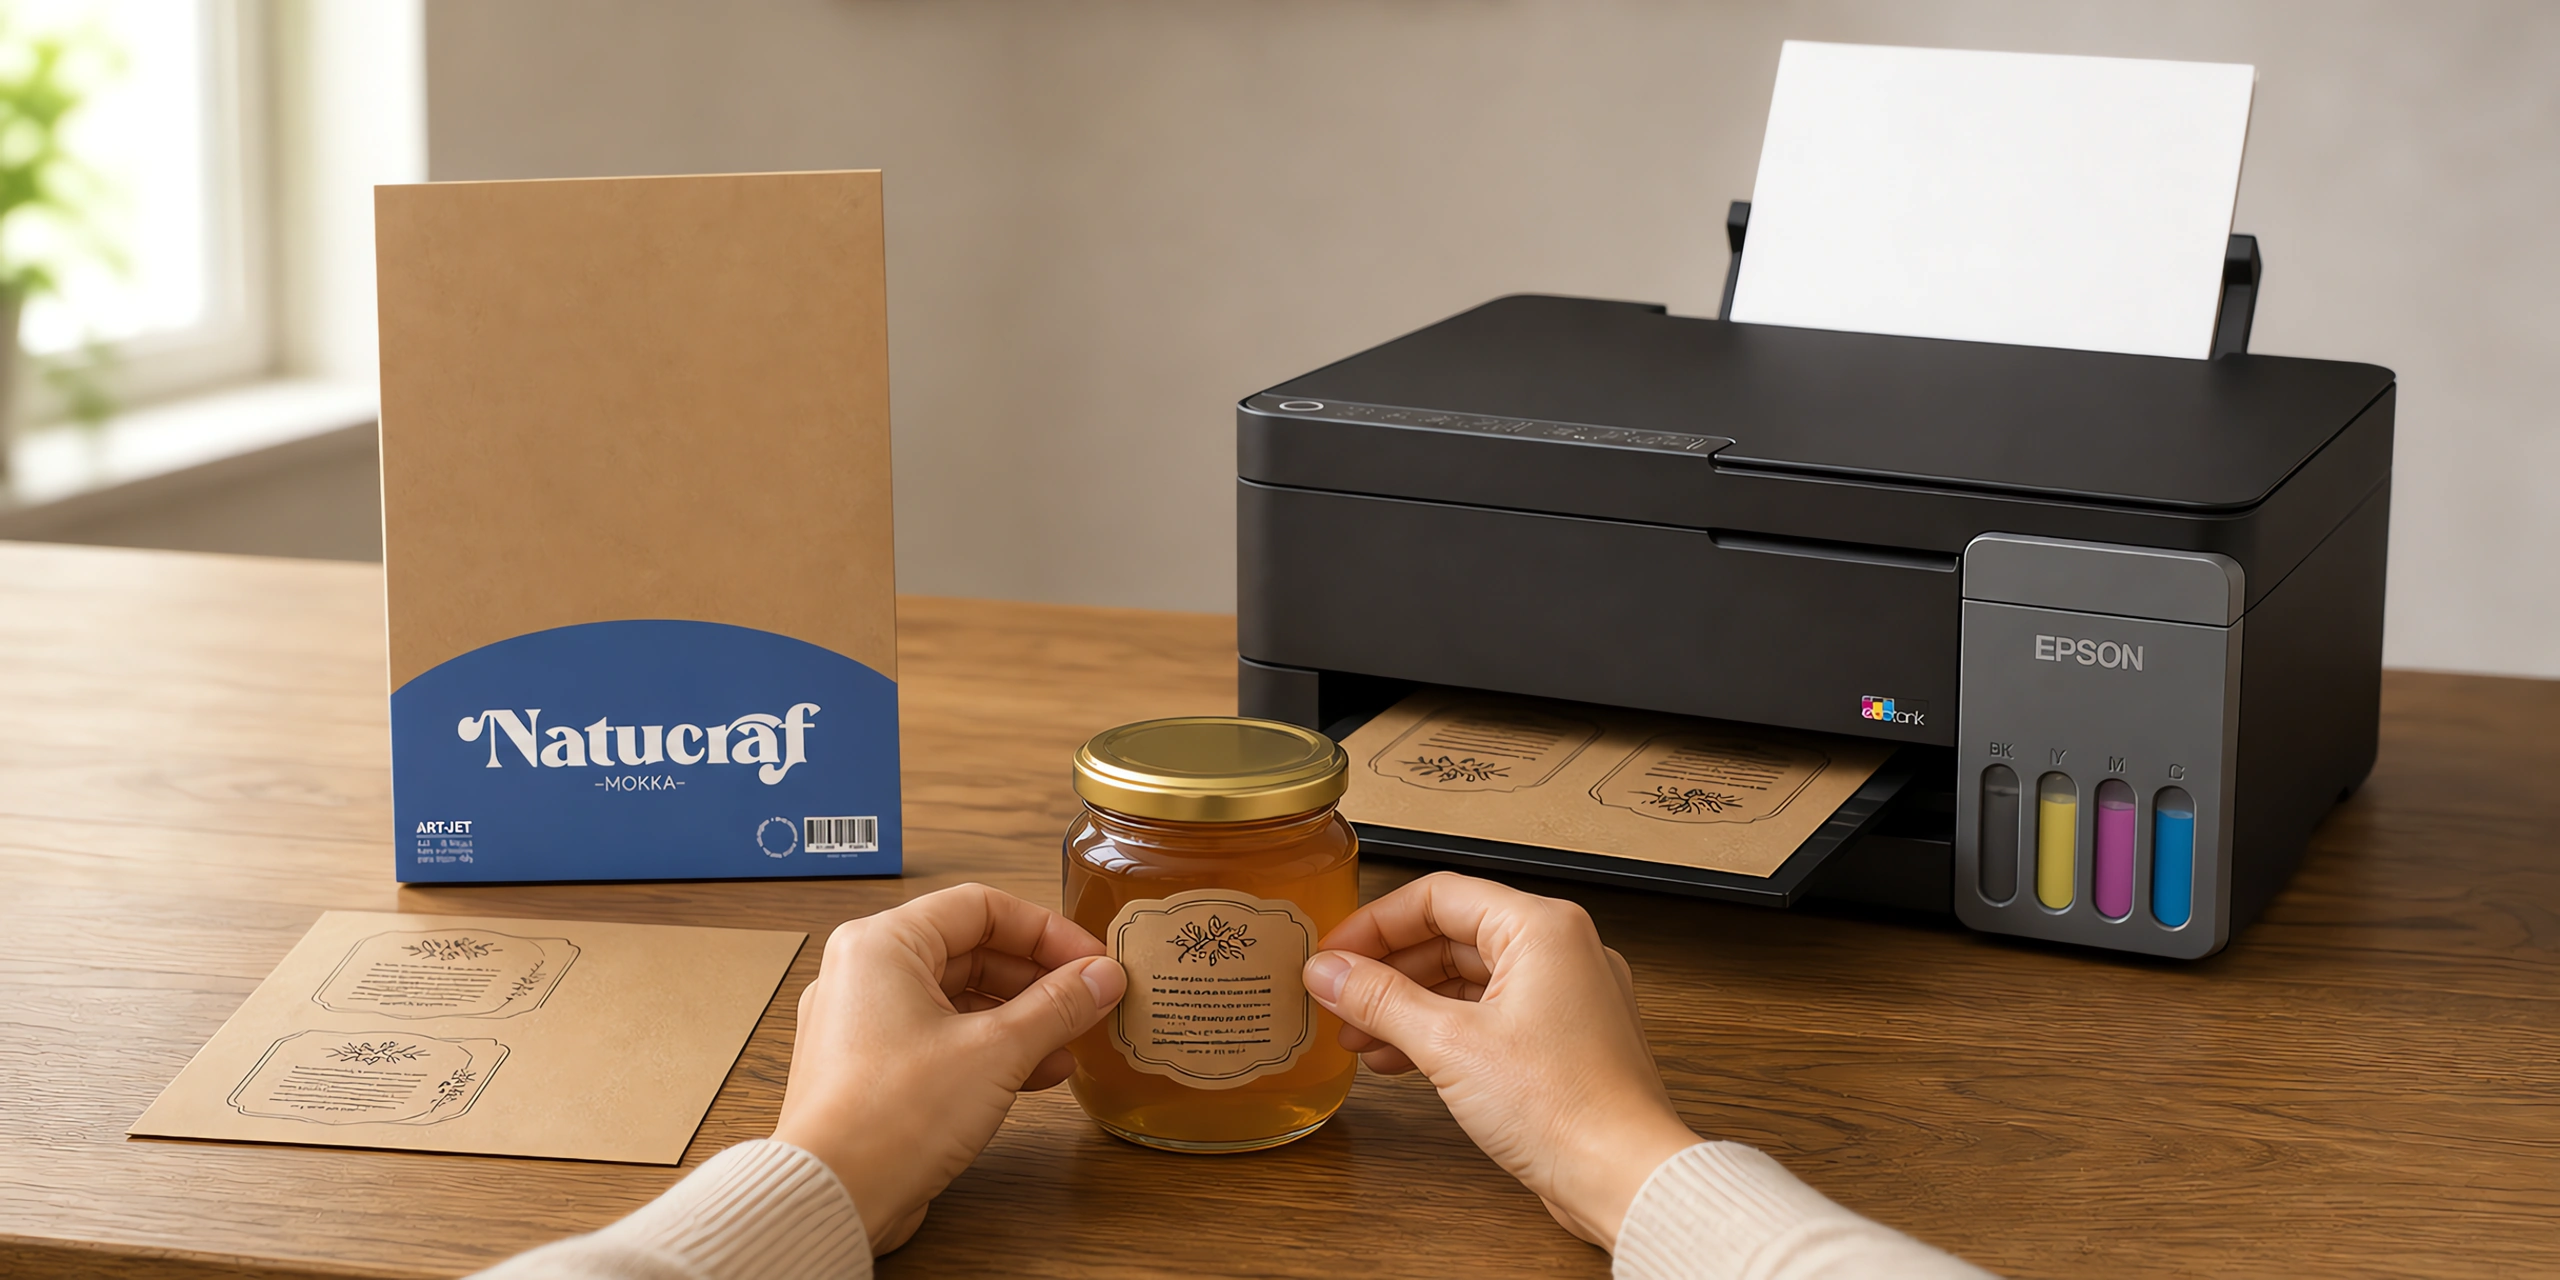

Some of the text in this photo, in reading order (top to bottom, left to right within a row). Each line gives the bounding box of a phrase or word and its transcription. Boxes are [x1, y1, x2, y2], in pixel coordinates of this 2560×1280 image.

[2034, 634, 2145, 671] EPSON
[457, 702, 822, 785] Natucraf
[1989, 742, 2015, 760] BK
[2050, 748, 2067, 766] Y
[2108, 756, 2126, 773] M
